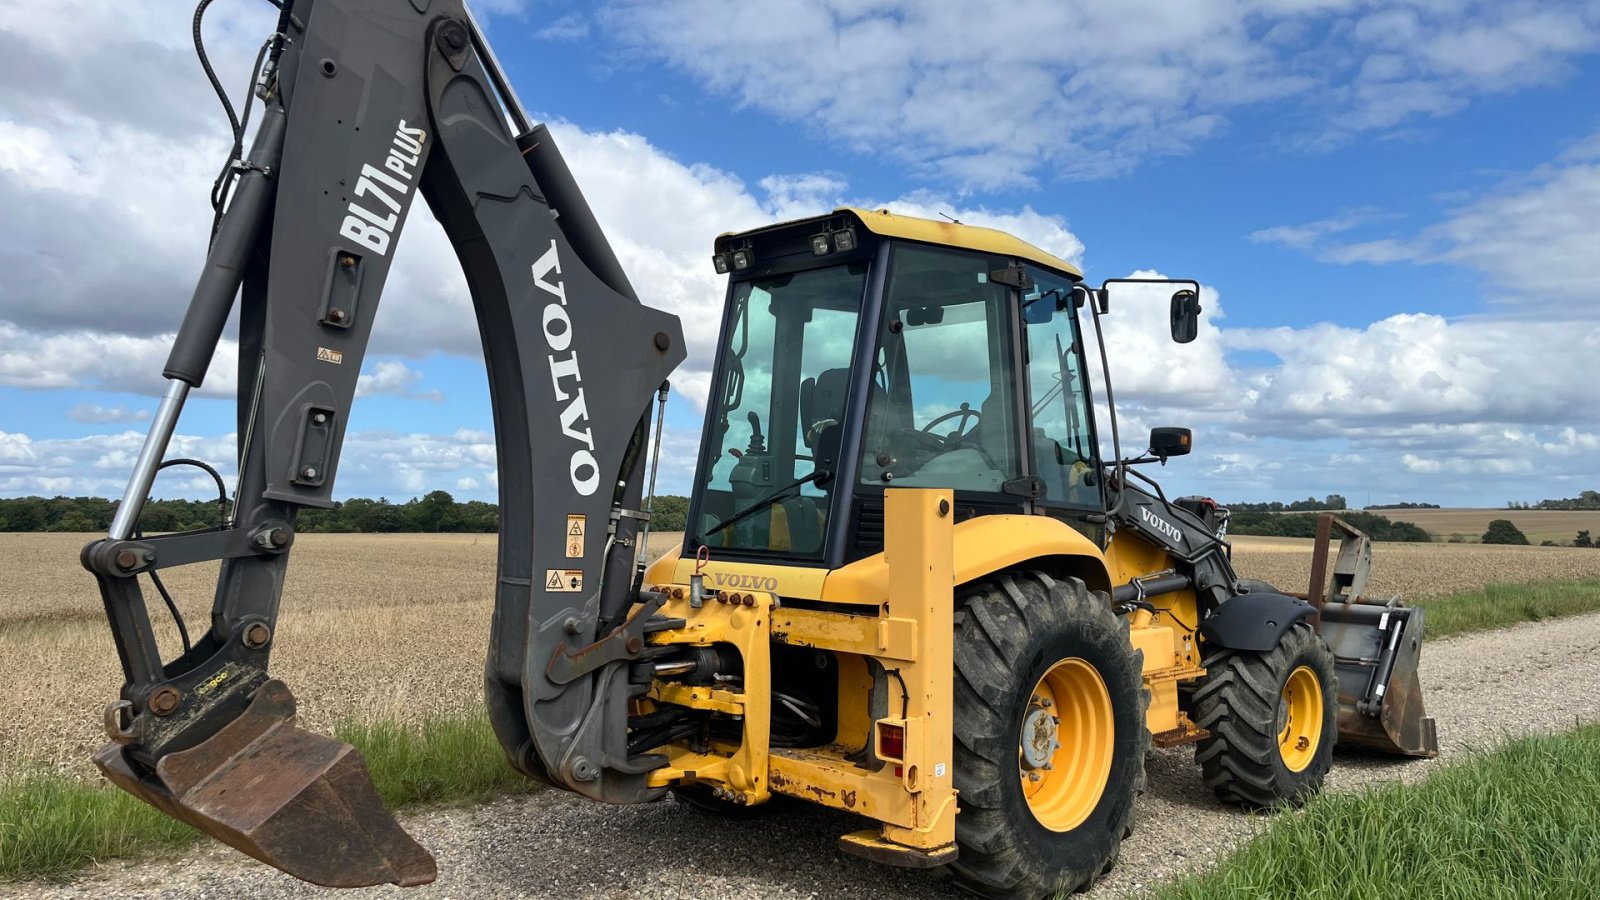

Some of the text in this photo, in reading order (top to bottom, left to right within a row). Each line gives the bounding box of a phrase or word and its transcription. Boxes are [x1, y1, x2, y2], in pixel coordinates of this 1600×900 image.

[340, 119, 427, 256] BL71 PLUS
[531, 239, 600, 496] VOLVO
[1140, 506, 1182, 542] VOLVO
[715, 572, 778, 591] VOLVO
